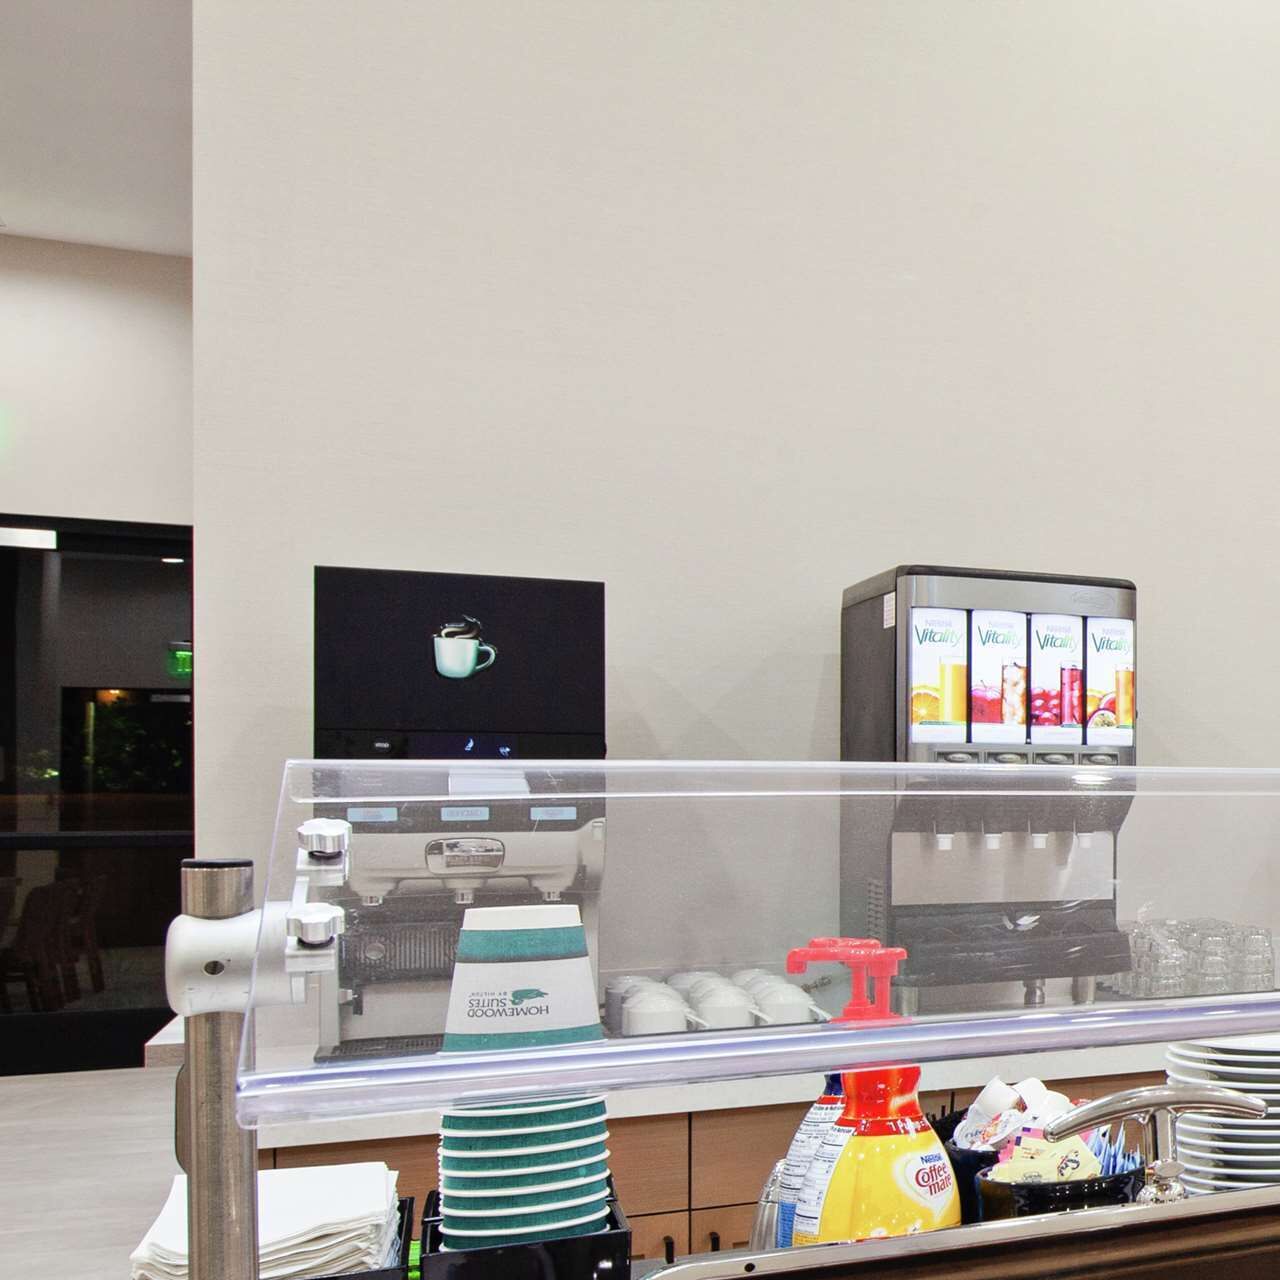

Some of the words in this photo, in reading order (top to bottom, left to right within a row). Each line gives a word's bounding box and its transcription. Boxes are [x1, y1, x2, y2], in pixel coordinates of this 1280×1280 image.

[914, 624, 963, 647] Vitality
[467, 1005, 549, 1018] HOMEWOOD
[468, 998, 507, 1008] SUITES
[915, 1162, 948, 1188] Coffee
